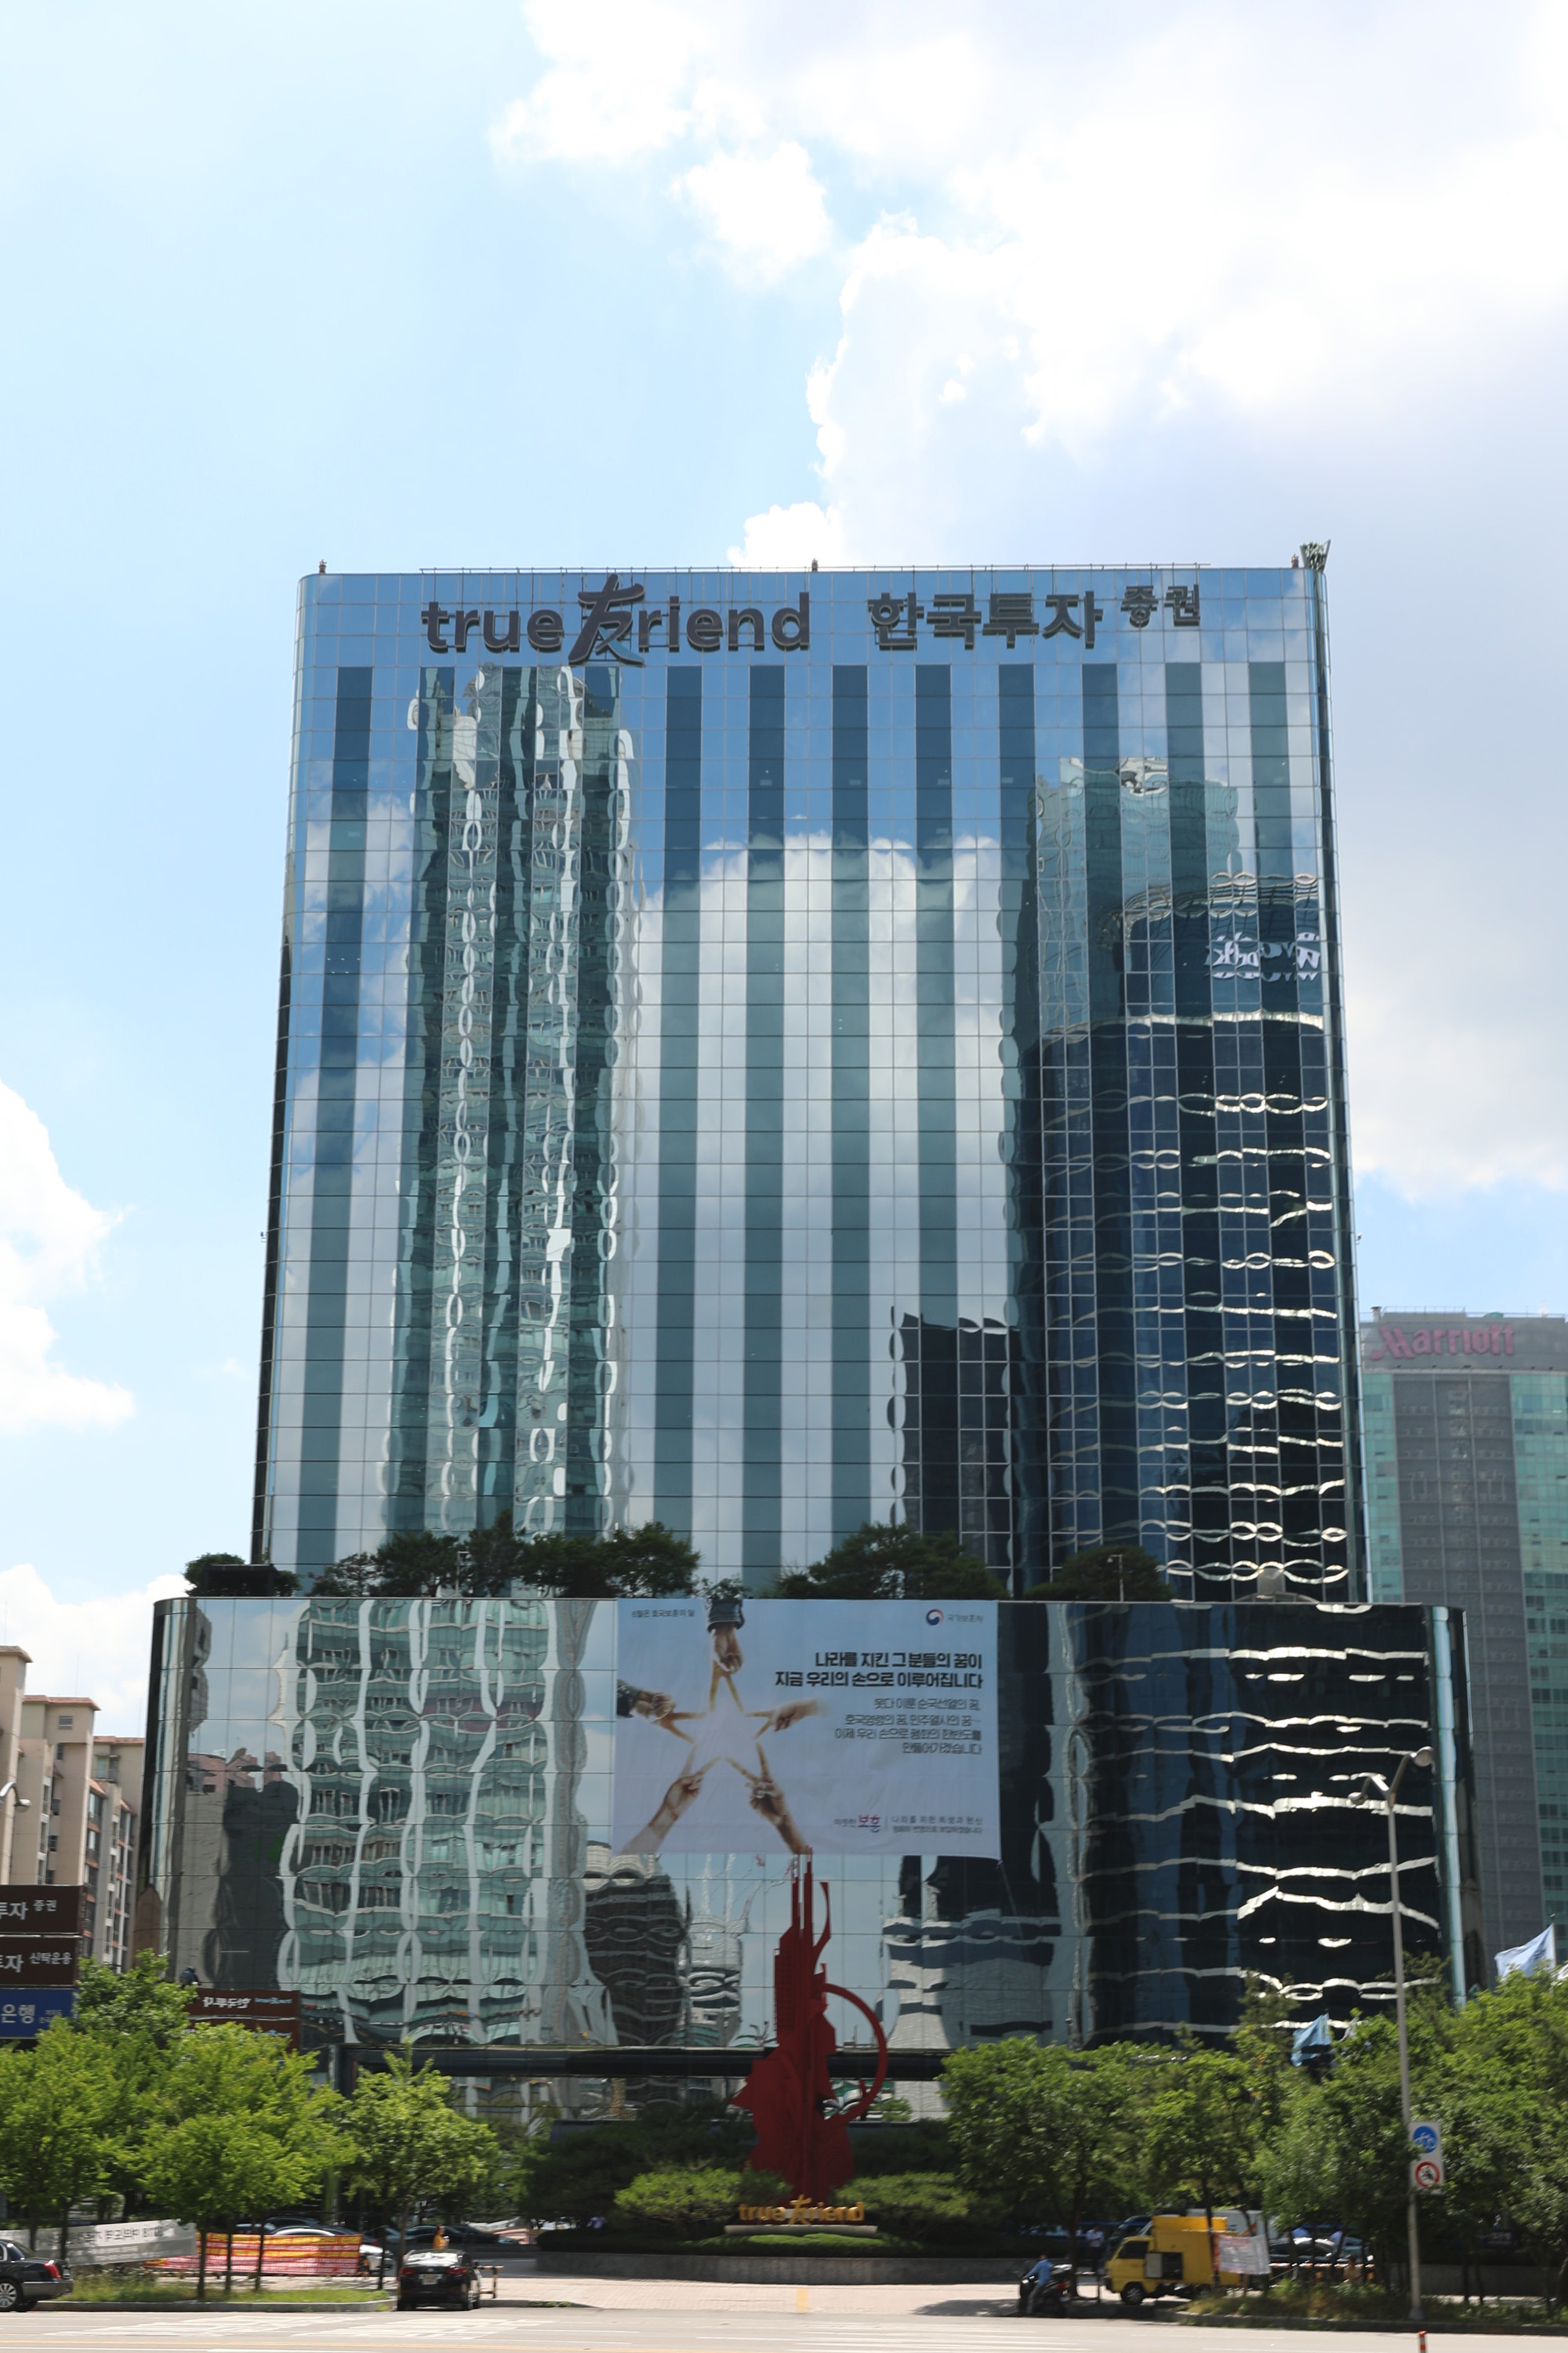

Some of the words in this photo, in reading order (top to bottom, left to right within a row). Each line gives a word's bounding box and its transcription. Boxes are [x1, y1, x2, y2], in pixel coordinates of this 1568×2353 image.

[867, 590, 1104, 651] 한국투자
[1121, 583, 1201, 627] 증권
[1370, 1323, 1515, 1360] Marriott
[815, 1652, 858, 1668] 나라를
[861, 1652, 888, 1668] 지킨
[953, 1653, 982, 1669] 꿈이
[775, 1671, 803, 1687] 지금
[806, 1671, 848, 1687] 우리의
[851, 1672, 894, 1687] 손으로
[898, 1672, 983, 1689] 이루어집니다
[878, 1728, 909, 1740] 손으로
[858, 1814, 881, 1833] 보훈
[34, 1899, 56, 1912] 증권
[0, 1954, 24, 1973] 자
[29, 1952, 72, 1966] 신탁운용
[1, 2004, 35, 2024] 은행
